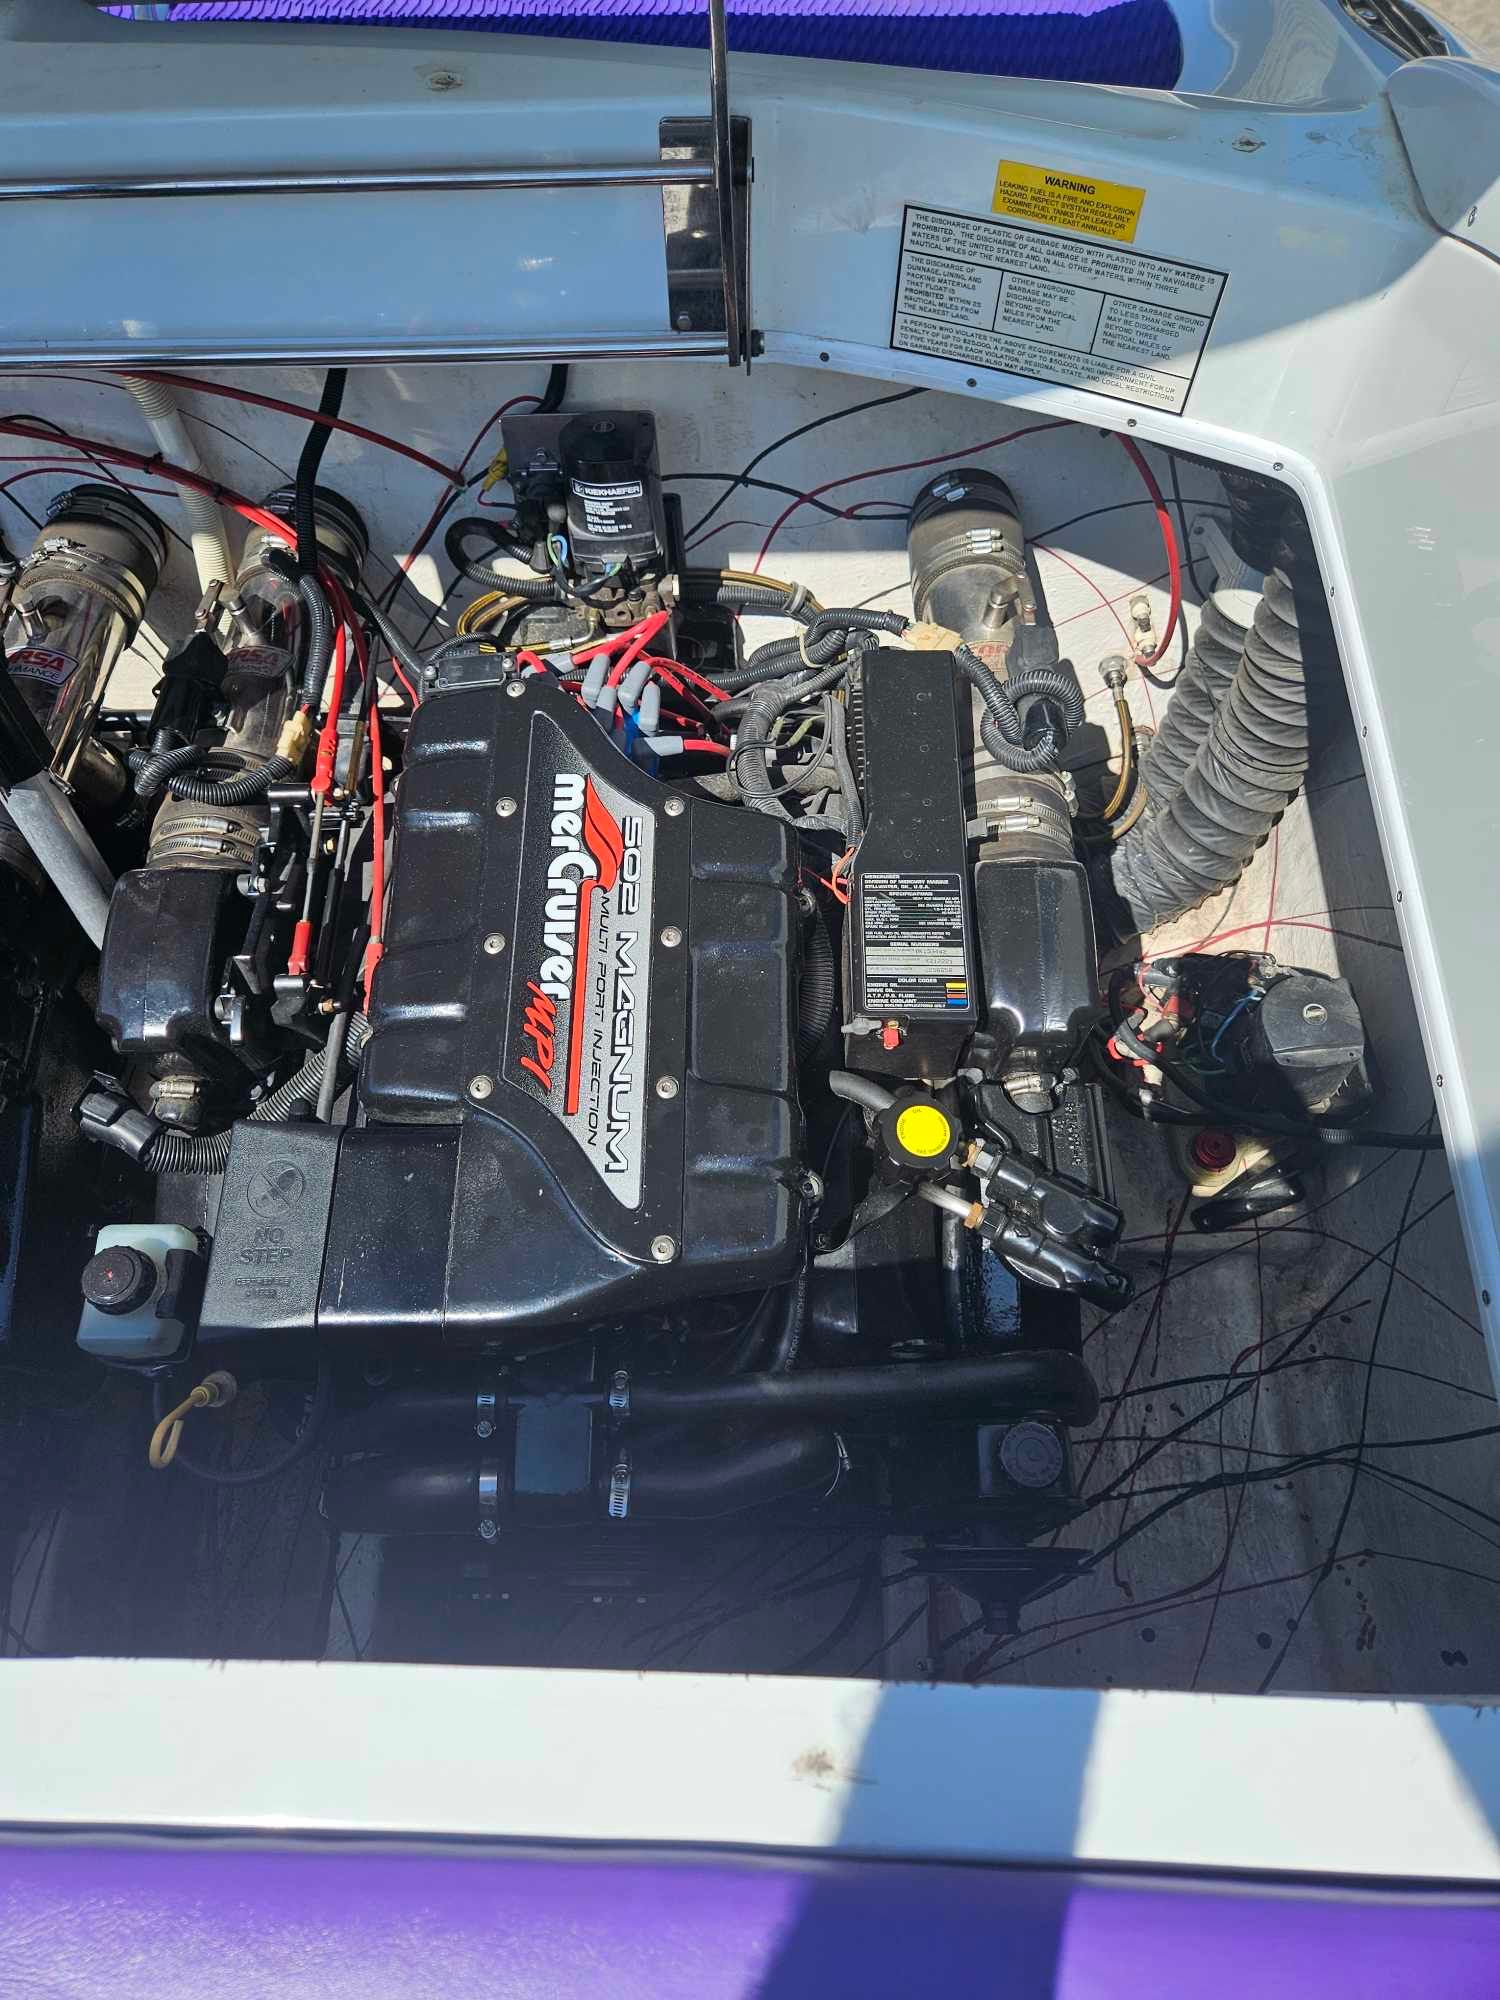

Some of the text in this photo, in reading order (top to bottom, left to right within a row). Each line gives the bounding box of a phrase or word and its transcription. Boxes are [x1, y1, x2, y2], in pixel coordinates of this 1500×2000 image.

[1045, 176, 1096, 195] WARNING
[1000, 180, 1028, 192] LEAKING
[1031, 187, 1047, 197] FUEL
[1049, 191, 1055, 199] IS
[1063, 195, 1078, 204] FIRE
[1080, 198, 1094, 207] AND
[1096, 202, 1136, 217] EXPLOSION
[1003, 198, 1032, 209] EXAMINE
[1034, 205, 1051, 213] FUEL
[1053, 209, 1074, 218] TANKS
[1092, 217, 1113, 227] LEAKS
[1031, 196, 1059, 207] INSPECT
[1062, 203, 1089, 214] SYSTEM
[1090, 209, 1131, 223] REGULARLY
[1007, 206, 1047, 220] CORROSION
[1059, 218, 1079, 227] LEAST
[1082, 223, 1116, 235] ANNUALLY
[910, 238, 941, 250] NAUTICAL
[946, 246, 966, 255] MILES
[968, 250, 977, 258] OF
[980, 253, 992, 261] THE
[995, 256, 1027, 268] NEAREST
[916, 214, 929, 222] THE
[931, 217, 970, 230] DISCHARGE
[973, 225, 982, 233] OF
[984, 228, 1012, 239] PLASTIC
[1026, 236, 1061, 249] GARBAGE
[1062, 244, 1084, 254] MIXED
[1087, 249, 1104, 259] WITH
[1138, 261, 1156, 270] INTO
[1158, 265, 1172, 274] ANY
[1175, 270, 1205, 282] WATERS
[912, 230, 939, 241] WATERS
[954, 239, 967, 247] THE
[969, 242, 994, 252] UNITED
[996, 248, 1023, 259] STATES
[1052, 260, 1066, 268] ALL
[1068, 263, 1092, 274] OTHER
[1127, 277, 1152, 288] WITHIN
[1155, 283, 1178, 294] THREE
[926, 259, 964, 271] DISCHARGE
[960, 231, 974, 239] THE
[1030, 246, 1044, 254] ALL
[1091, 260, 1134, 274] PROHIBITED
[1146, 272, 1161, 280] THE
[1163, 276, 1204, 290] NAVIGABLE
[907, 271, 976, 291] PACKING MATERIALS
[926, 283, 947, 293] FLOAT
[968, 276, 982, 284] AND
[1011, 277, 1075, 296] OTHER UNGROUND
[905, 287, 971, 305] PROHIBITED WITHIN
[1007, 292, 1050, 306] DISCHARGED
[1008, 284, 1056, 300] GARBAGE MAY
[904, 295, 979, 315] NAUTICAL MILES FROM
[904, 302, 918, 310] THE
[1004, 308, 1024, 317] MILES
[1026, 313, 1045, 321] FROM
[1005, 300, 1077, 321] BEYOND NAUTICAL
[1113, 300, 1205, 327] OTHER GARBAGE GROUND
[1107, 315, 1180, 337] MAY DISCHARGED
[1120, 310, 1139, 319] LESS
[1141, 315, 1160, 325] THAN
[1162, 320, 1176, 329] ONE
[1103, 331, 1160, 349] NAUTICAL MILES
[1105, 324, 1158, 340] BEYOND THREE
[901, 325, 929, 336] PENALTY
[1081, 366, 1094, 374] AND
[1097, 370, 1147, 387] IMPRISONMENT
[910, 320, 936, 330] PERSON
[939, 326, 953, 334] WHO
[956, 330, 987, 341] VIOLATES
[1004, 340, 1026, 350] ABOVE
[1028, 346, 1080, 363] REQUIREMENTS
[1091, 361, 1114, 371] LIABLE
[1116, 367, 1130, 375] FOR
[1139, 373, 1156, 381] CIVIL
[910, 343, 939, 353] GARBAGE
[942, 349, 984, 363] DISCHARGES
[986, 359, 1002, 367] ALSO
[1102, 338, 1115, 346] THE
[1117, 342, 1149, 355] NEAREST
[927, 339, 947, 347] YEARS
[965, 347, 982, 355] EACH
[1087, 375, 1099, 383] AND
[1102, 379, 1122, 388] LOCAL
[1125, 385, 1175, 402] RESTRICTIONS
[604, 816, 643, 1173] 502 MAGNUM
[586, 895, 610, 1147] MULTI PORT INJECTION
[520, 980, 556, 1094] MPI
[255, 1227, 284, 1244] NO
[240, 1247, 294, 1264] STEP
